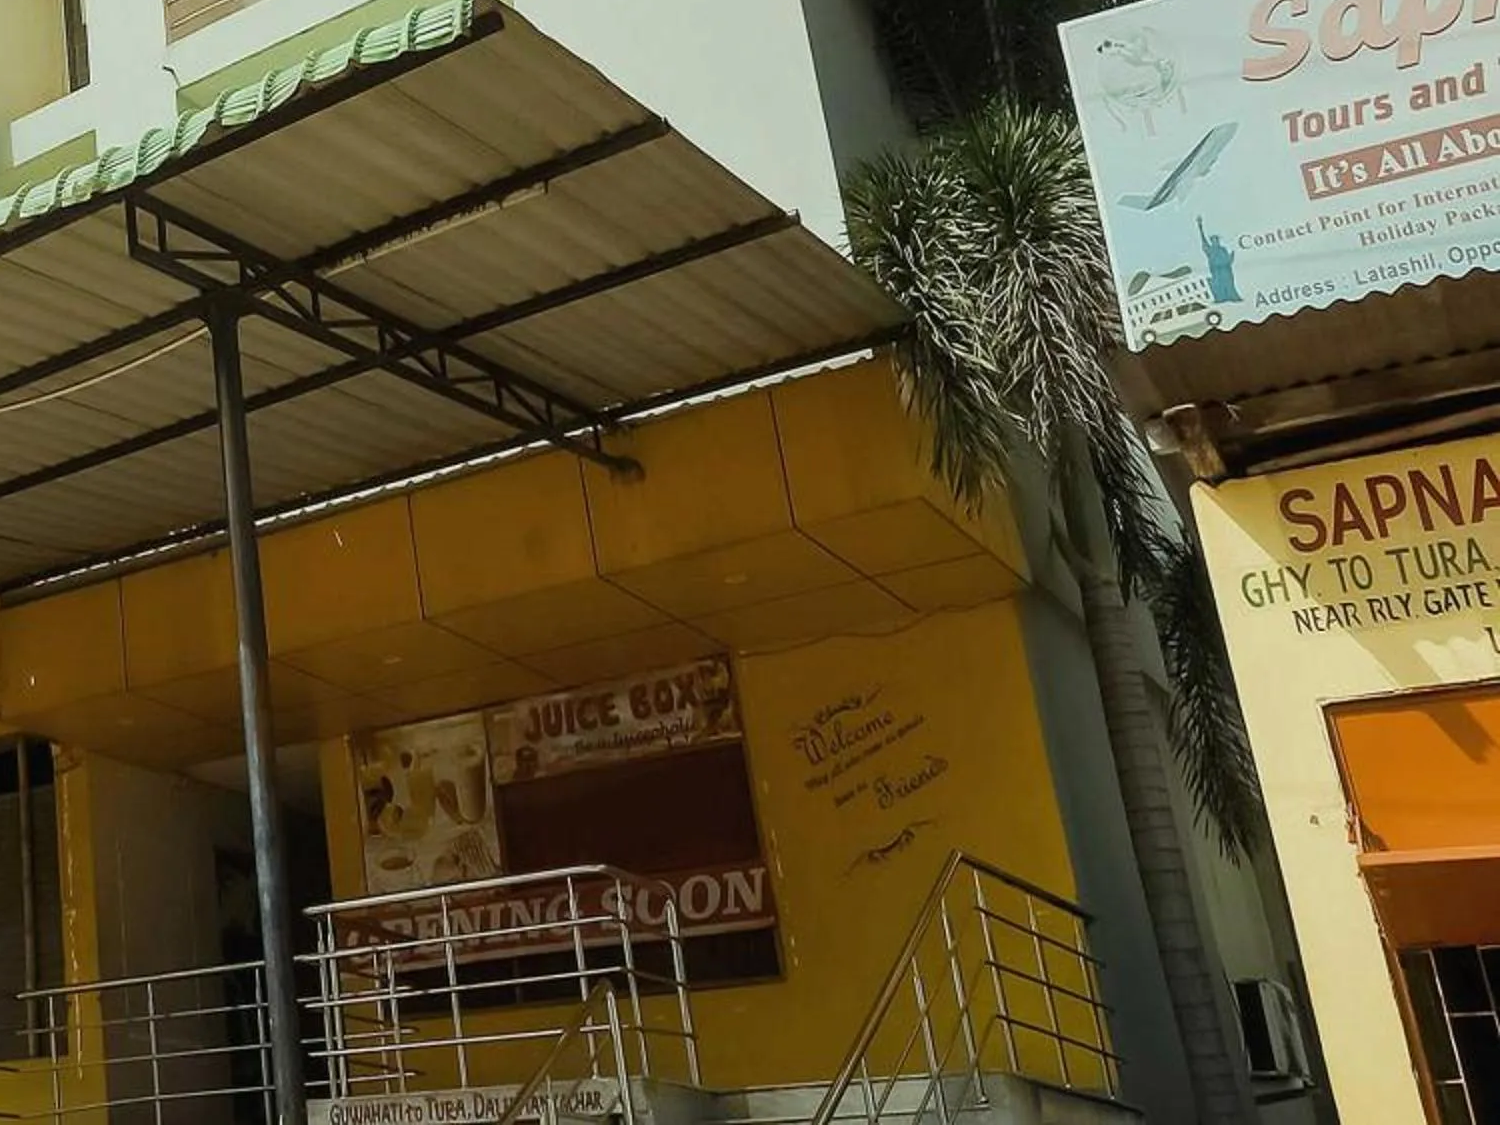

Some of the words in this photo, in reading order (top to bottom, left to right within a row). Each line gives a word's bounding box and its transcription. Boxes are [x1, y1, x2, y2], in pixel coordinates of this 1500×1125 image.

[1282, 92, 1393, 143] Tours
[1409, 62, 1485, 111] and
[1376, 140, 1428, 177] All
[1238, 221, 1313, 249] Contact
[1319, 208, 1371, 230] Point
[1378, 199, 1406, 217] for
[1359, 219, 1437, 246] Holiday
[1256, 279, 1335, 307] Address
[1279, 458, 1500, 553] SAPNA
[1328, 554, 1373, 594] TO
[1293, 602, 1360, 634] NEAR
[1424, 581, 1493, 616] GATE
[524, 692, 621, 743] JUICE
[628, 671, 698, 719] BOX
